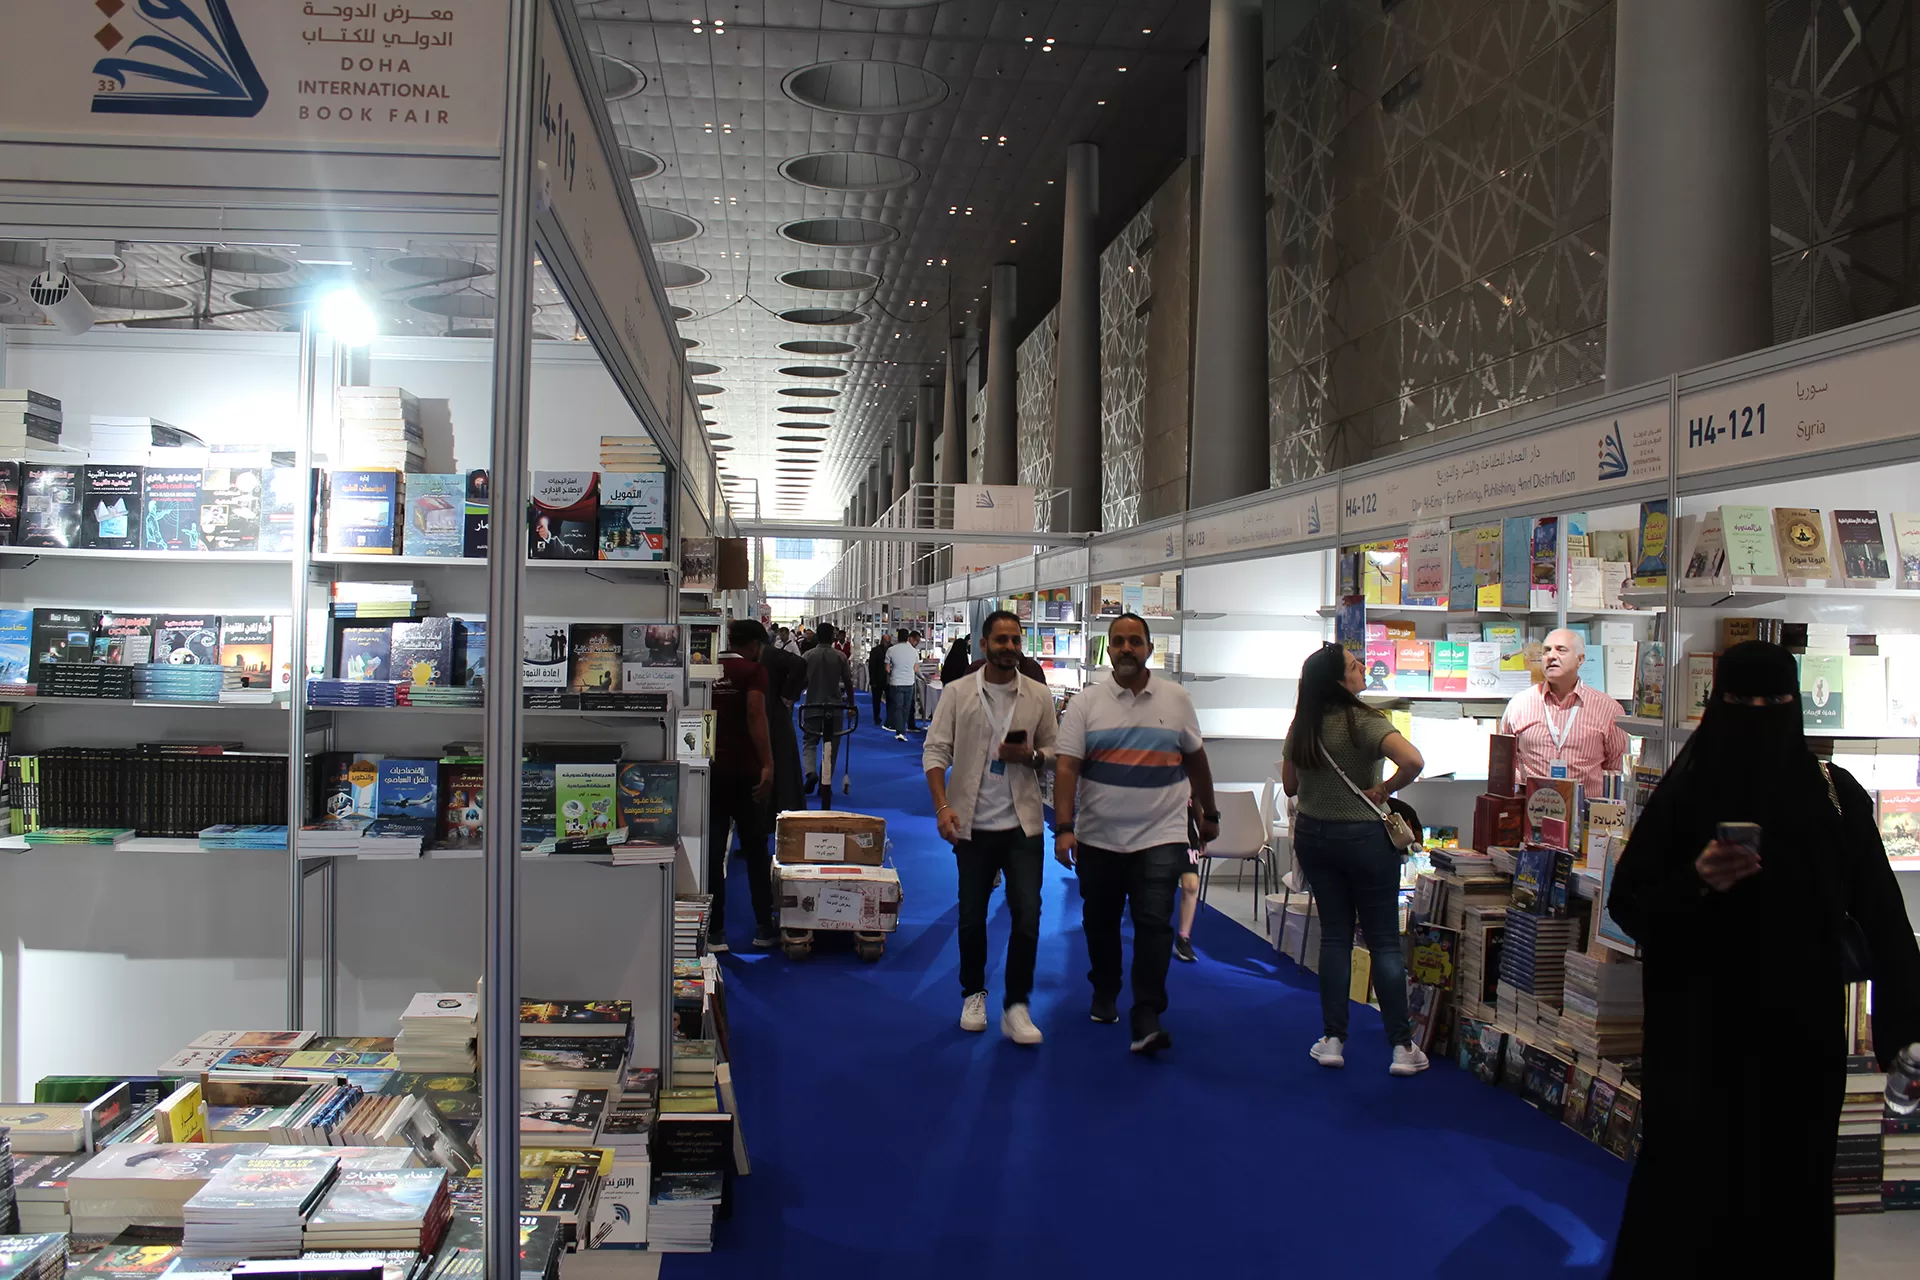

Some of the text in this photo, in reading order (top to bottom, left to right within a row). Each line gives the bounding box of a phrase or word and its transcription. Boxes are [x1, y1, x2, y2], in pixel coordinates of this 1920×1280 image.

[303, 1, 454, 24] معرض الدوحة
[302, 27, 453, 50] الدولي للكتاب
[341, 57, 411, 73] DOHA
[97, 80, 116, 92] 33
[298, 80, 450, 99] INTERNATIONAL
[299, 105, 449, 124] BOOK FAIR
[1796, 381, 1829, 401] سوريا
[1688, 403, 1766, 448] H4-121
[1796, 420, 1827, 442] Syria
[1484, 480, 1516, 497] Publishing
[1517, 475, 1532, 491] And
[1533, 469, 1576, 489] Distribution
[610, 489, 642, 500] التمويل
[1345, 493, 1377, 518] H4-122
[1187, 531, 1205, 547] H4-123
[542, 668, 560, 677] إعادة
[403, 1170, 433, 1180] نساء
